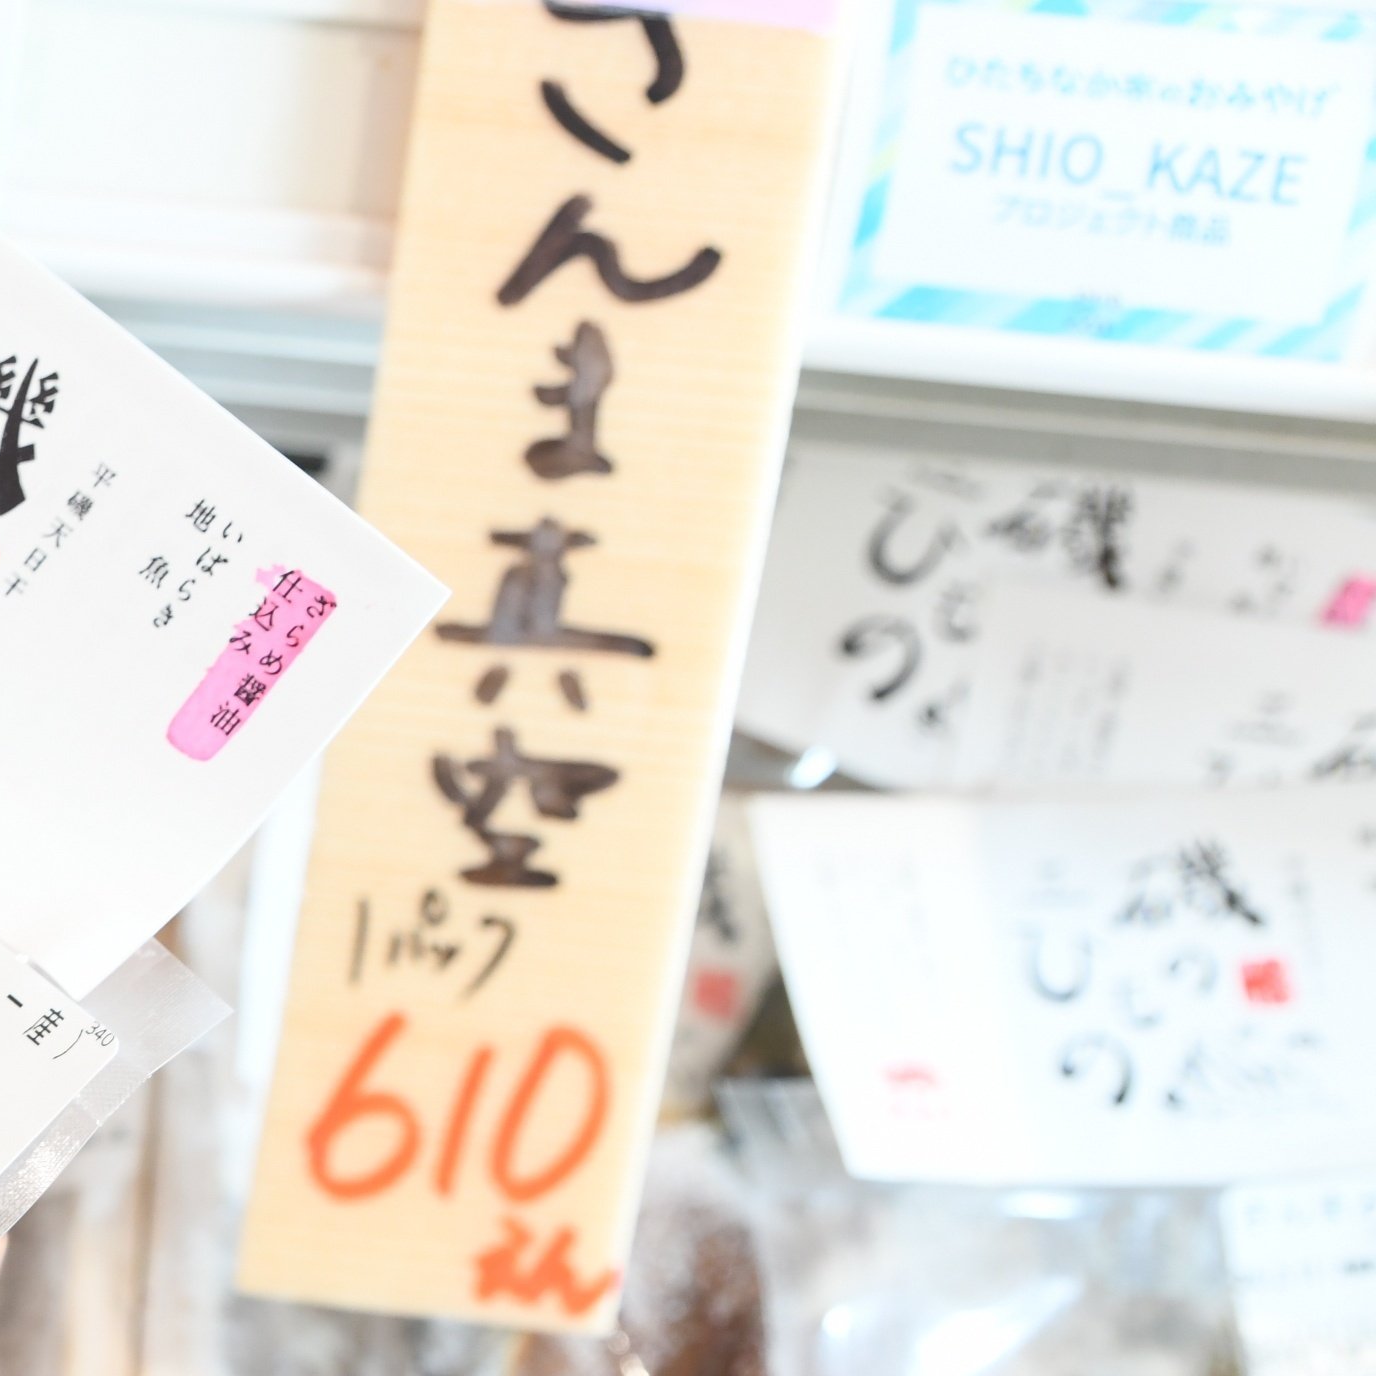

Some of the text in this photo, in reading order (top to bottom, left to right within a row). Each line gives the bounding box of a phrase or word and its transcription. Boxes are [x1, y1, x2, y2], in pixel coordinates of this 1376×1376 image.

[229, 570, 302, 655] 仕込み
[84, 1022, 116, 1048] 340
[305, 1011, 612, 1204] 610
